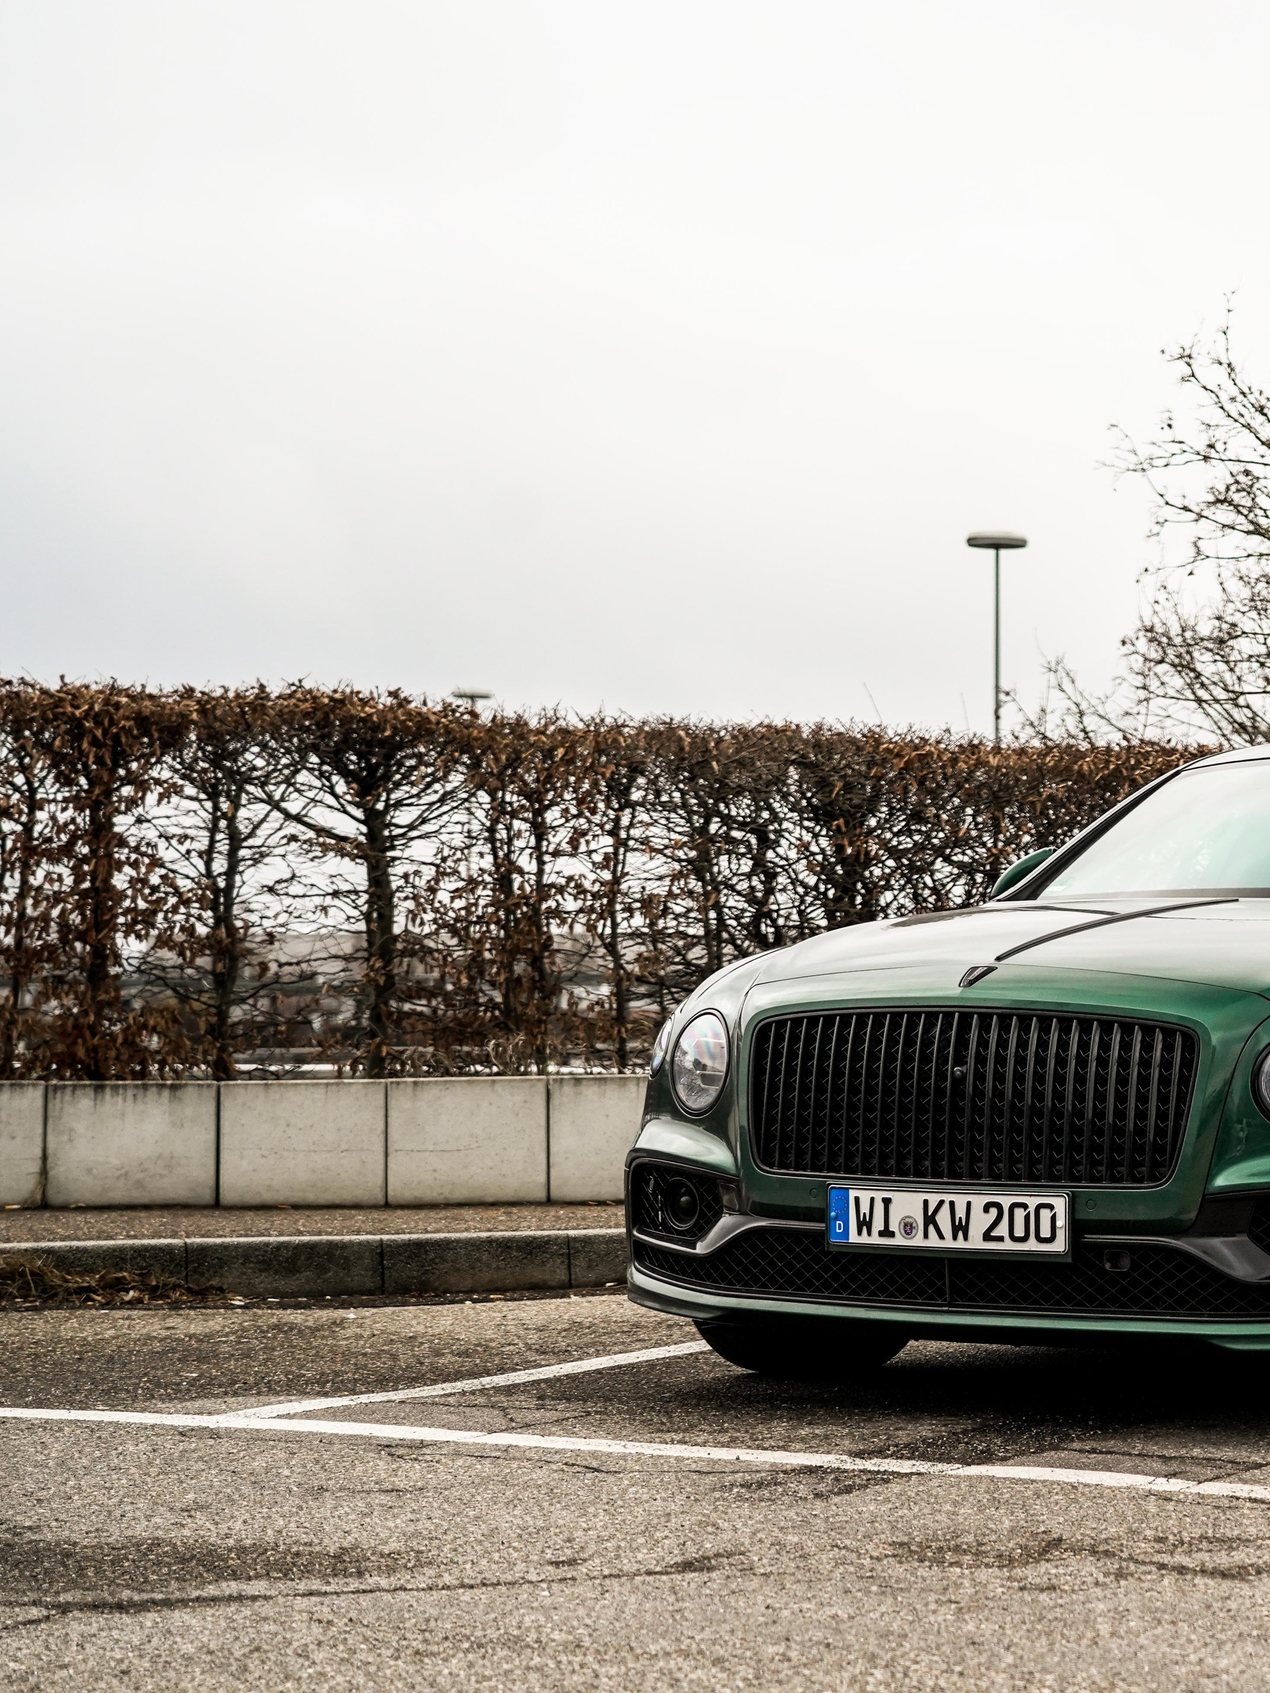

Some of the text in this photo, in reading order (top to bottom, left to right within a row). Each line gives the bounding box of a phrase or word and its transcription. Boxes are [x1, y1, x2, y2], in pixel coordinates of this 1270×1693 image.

[835, 1221, 844, 1233] D
[854, 1195, 1057, 1243] WI KW 200
